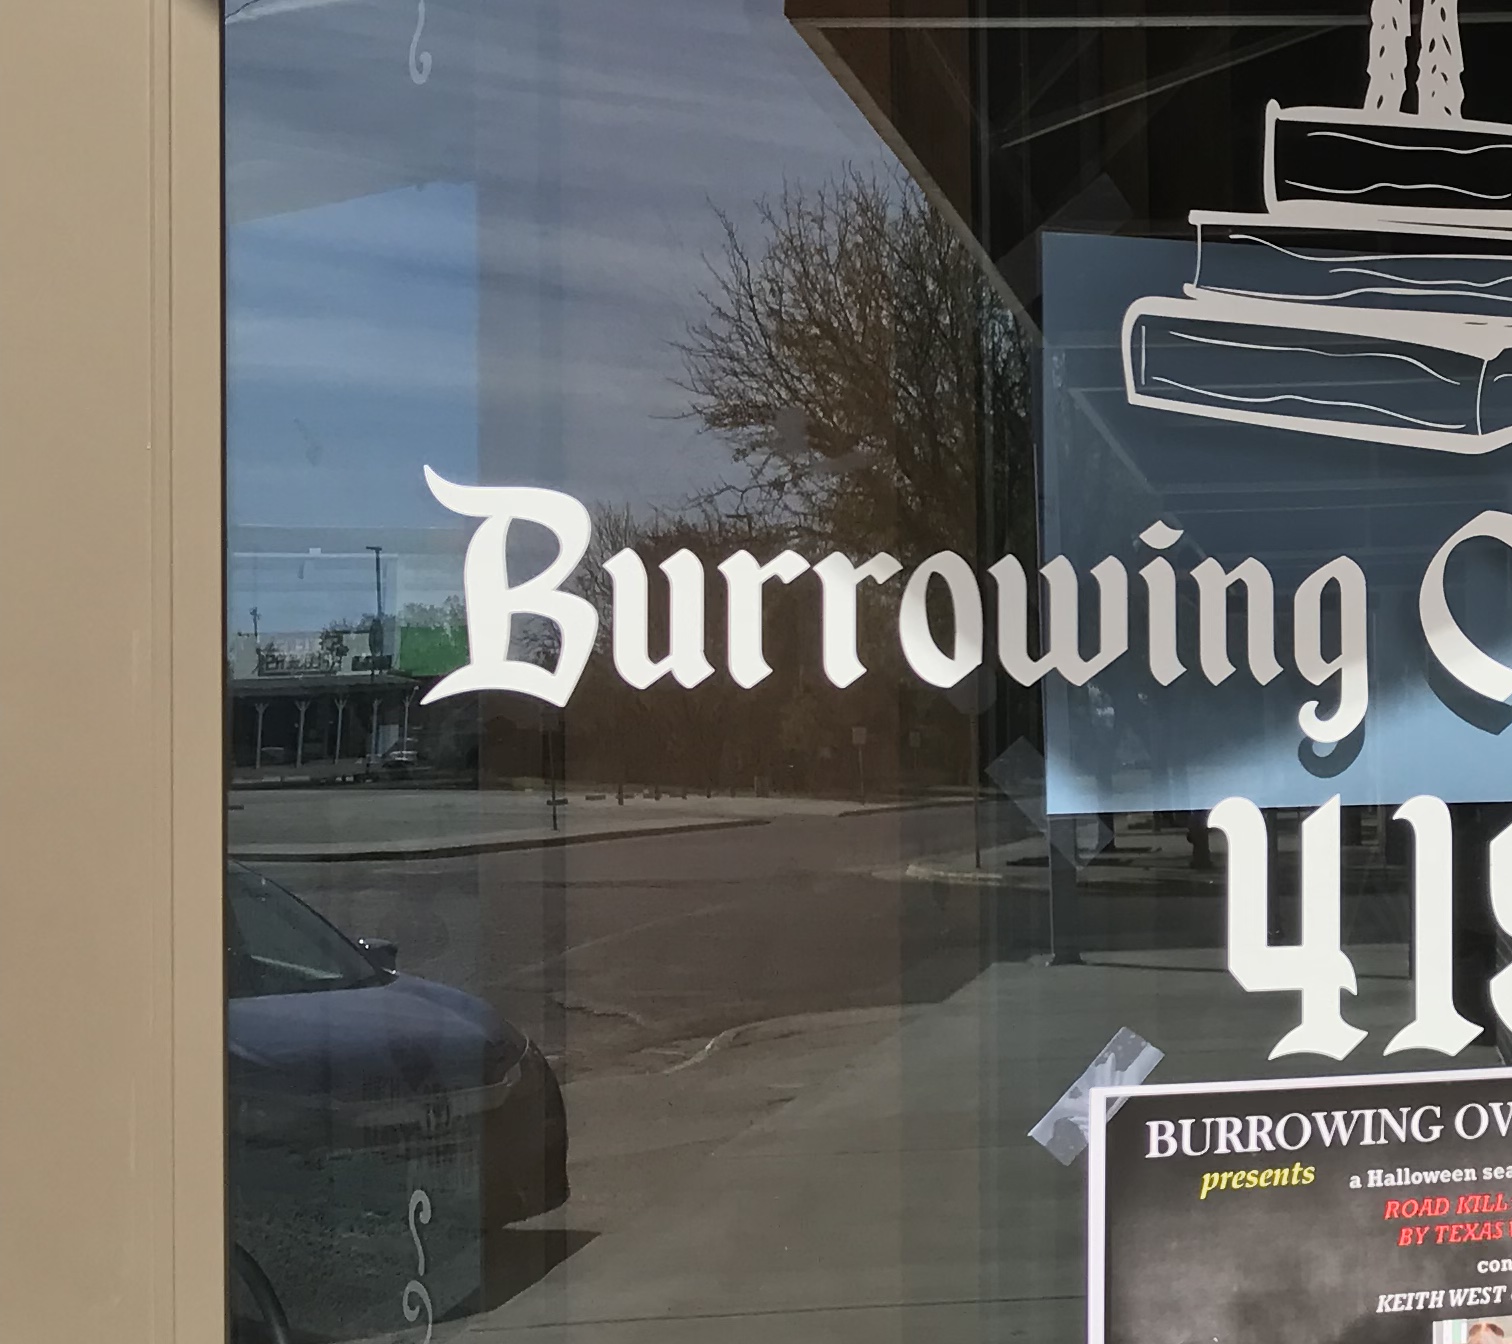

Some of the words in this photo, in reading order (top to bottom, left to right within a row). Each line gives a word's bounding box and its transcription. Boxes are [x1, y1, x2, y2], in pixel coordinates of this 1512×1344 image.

[420, 465, 1368, 742] Burrowing
[1145, 1105, 1444, 1158] BURROWING
[1200, 1162, 1316, 1199] presents
[1349, 1174, 1362, 1189] a
[1367, 1166, 1477, 1188] Halloween
[1384, 1197, 1450, 1220] ROAD
[1398, 1225, 1430, 1246] BY
[1434, 1221, 1504, 1243] TEXAS
[1376, 1289, 1446, 1313] KEITH
[1449, 1285, 1507, 1307] WEST
